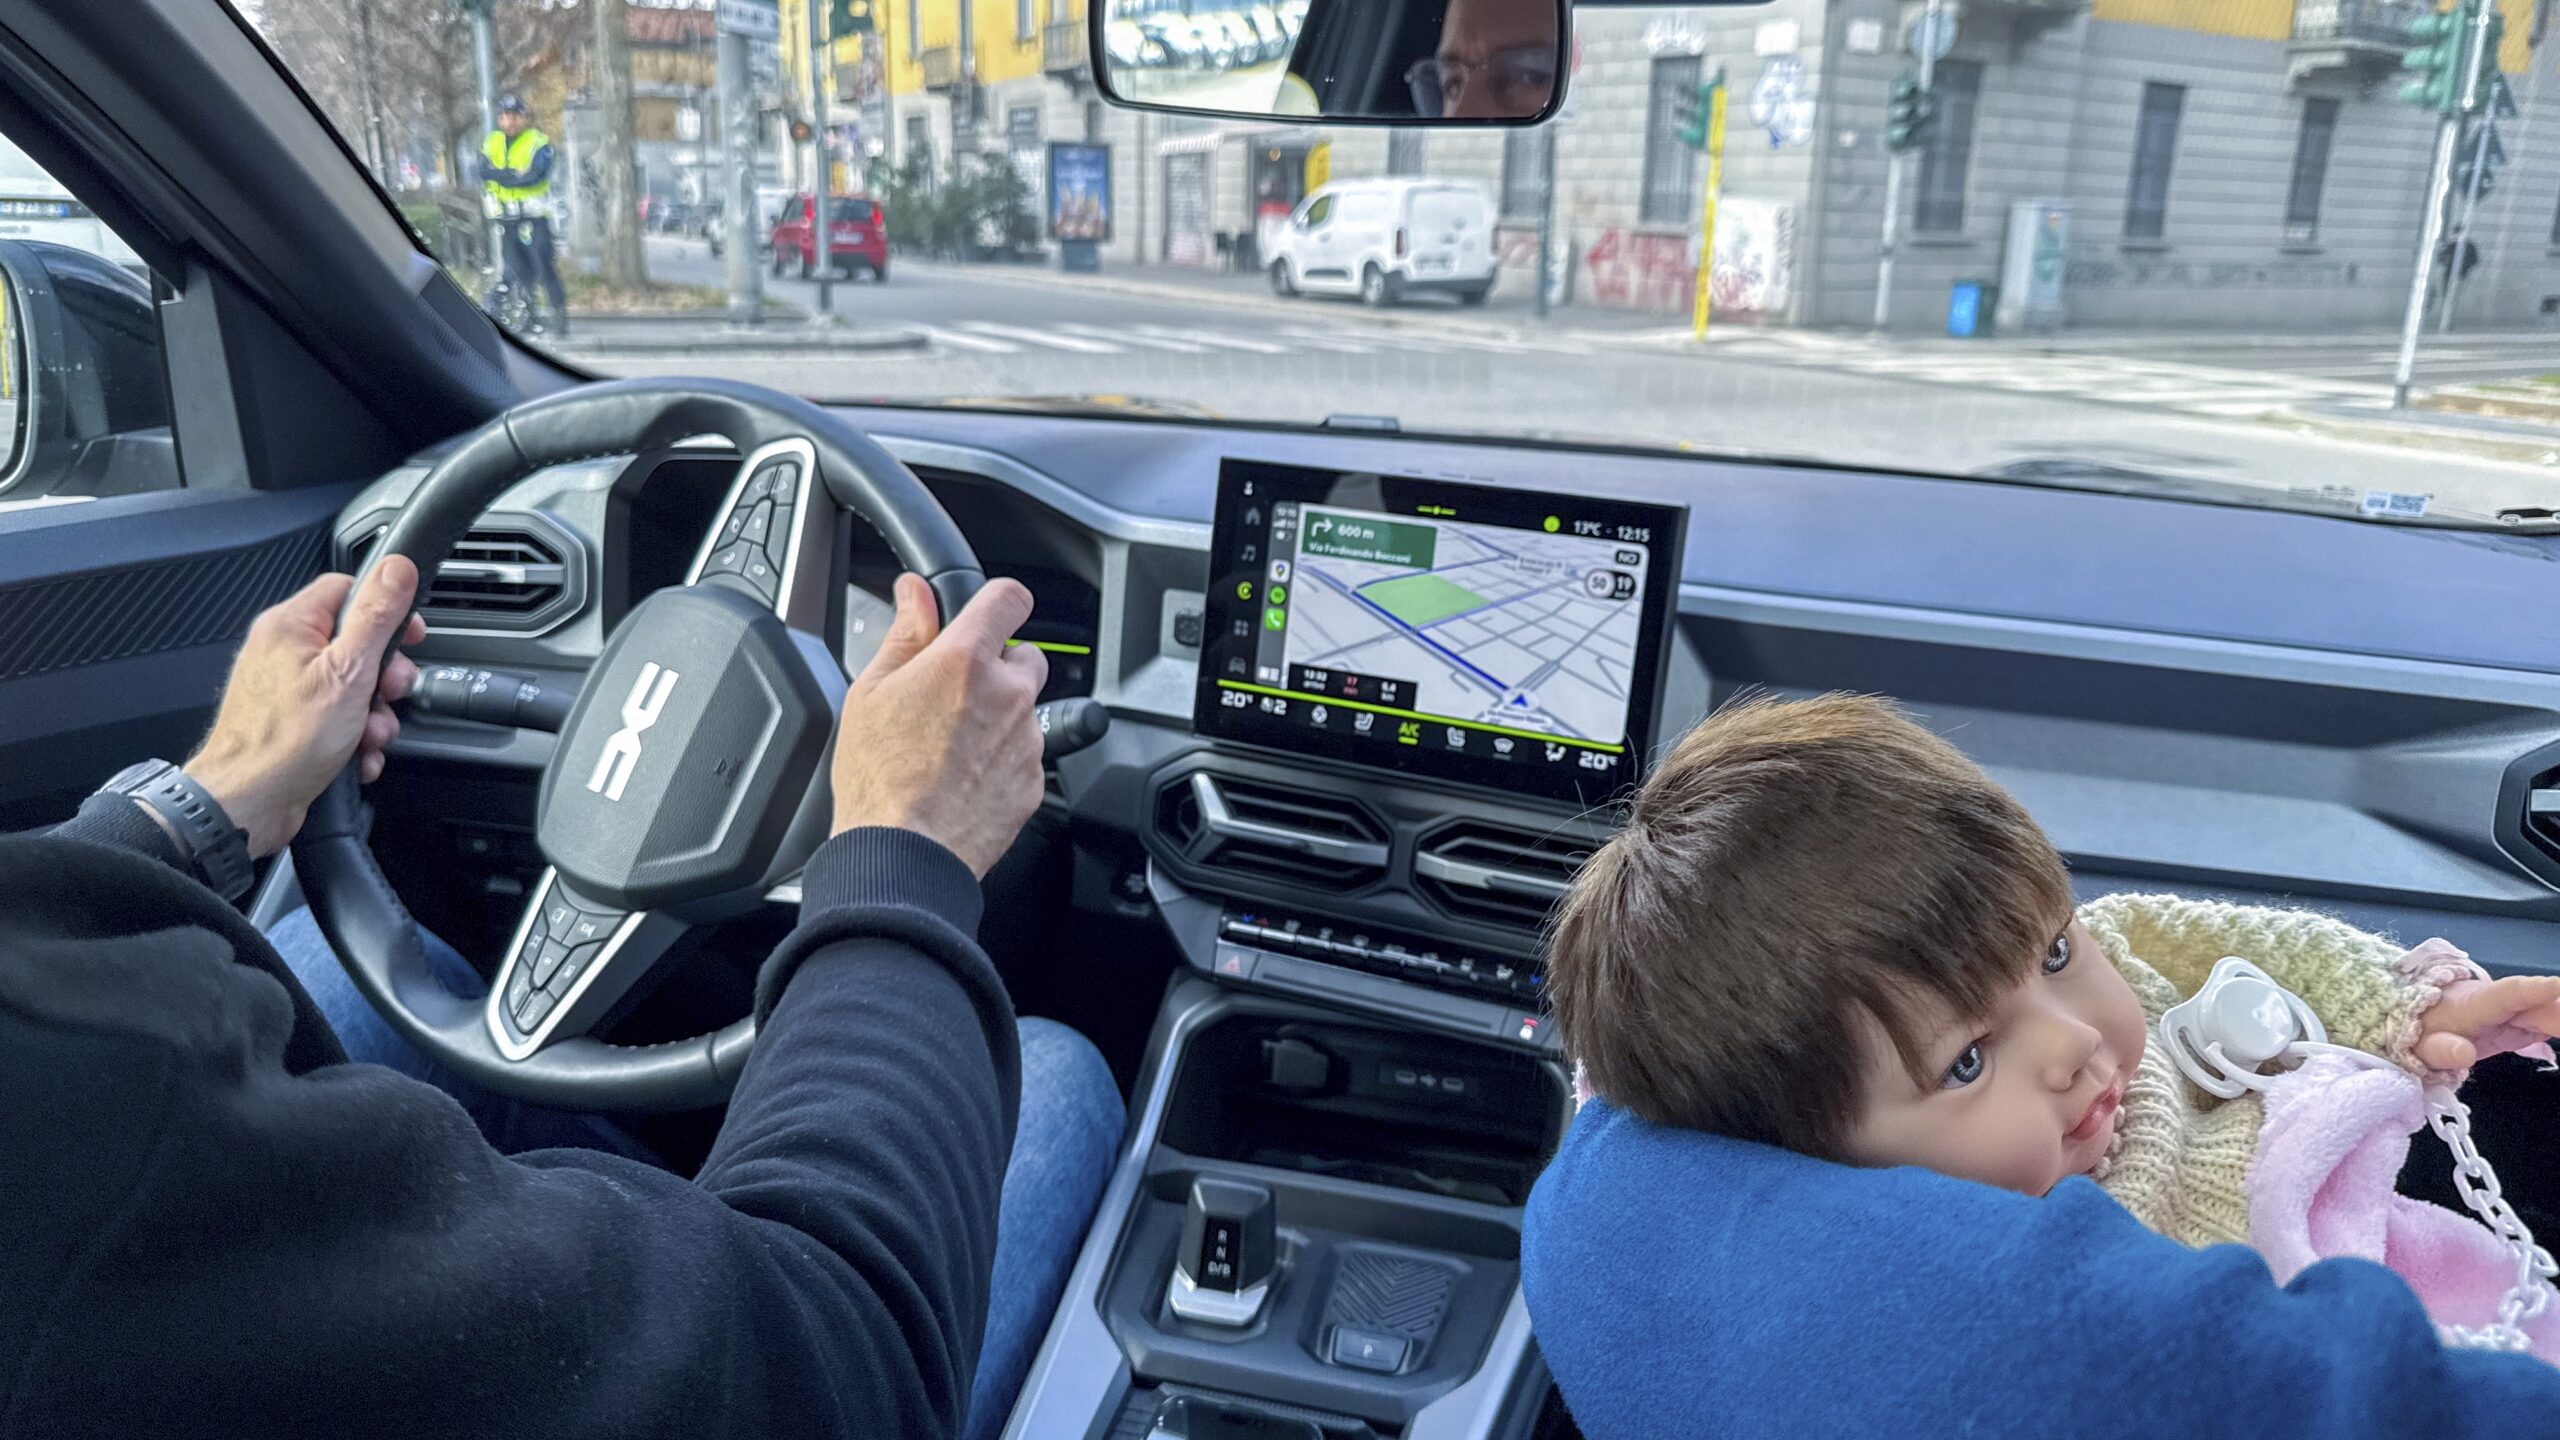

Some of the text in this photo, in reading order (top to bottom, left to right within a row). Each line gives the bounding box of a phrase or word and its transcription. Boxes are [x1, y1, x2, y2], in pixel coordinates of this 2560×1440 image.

[1337, 523, 1375, 540] 600 m
[1617, 526, 1650, 543] 12:15
[1308, 542, 1324, 552] Via
[1618, 552, 1638, 565] NO
[1592, 576, 1607, 590] 50
[1617, 576, 1633, 591] 19
[1398, 722, 1421, 738] A/C
[1217, 1229, 1228, 1244] R
[1215, 1245, 1227, 1260] N
